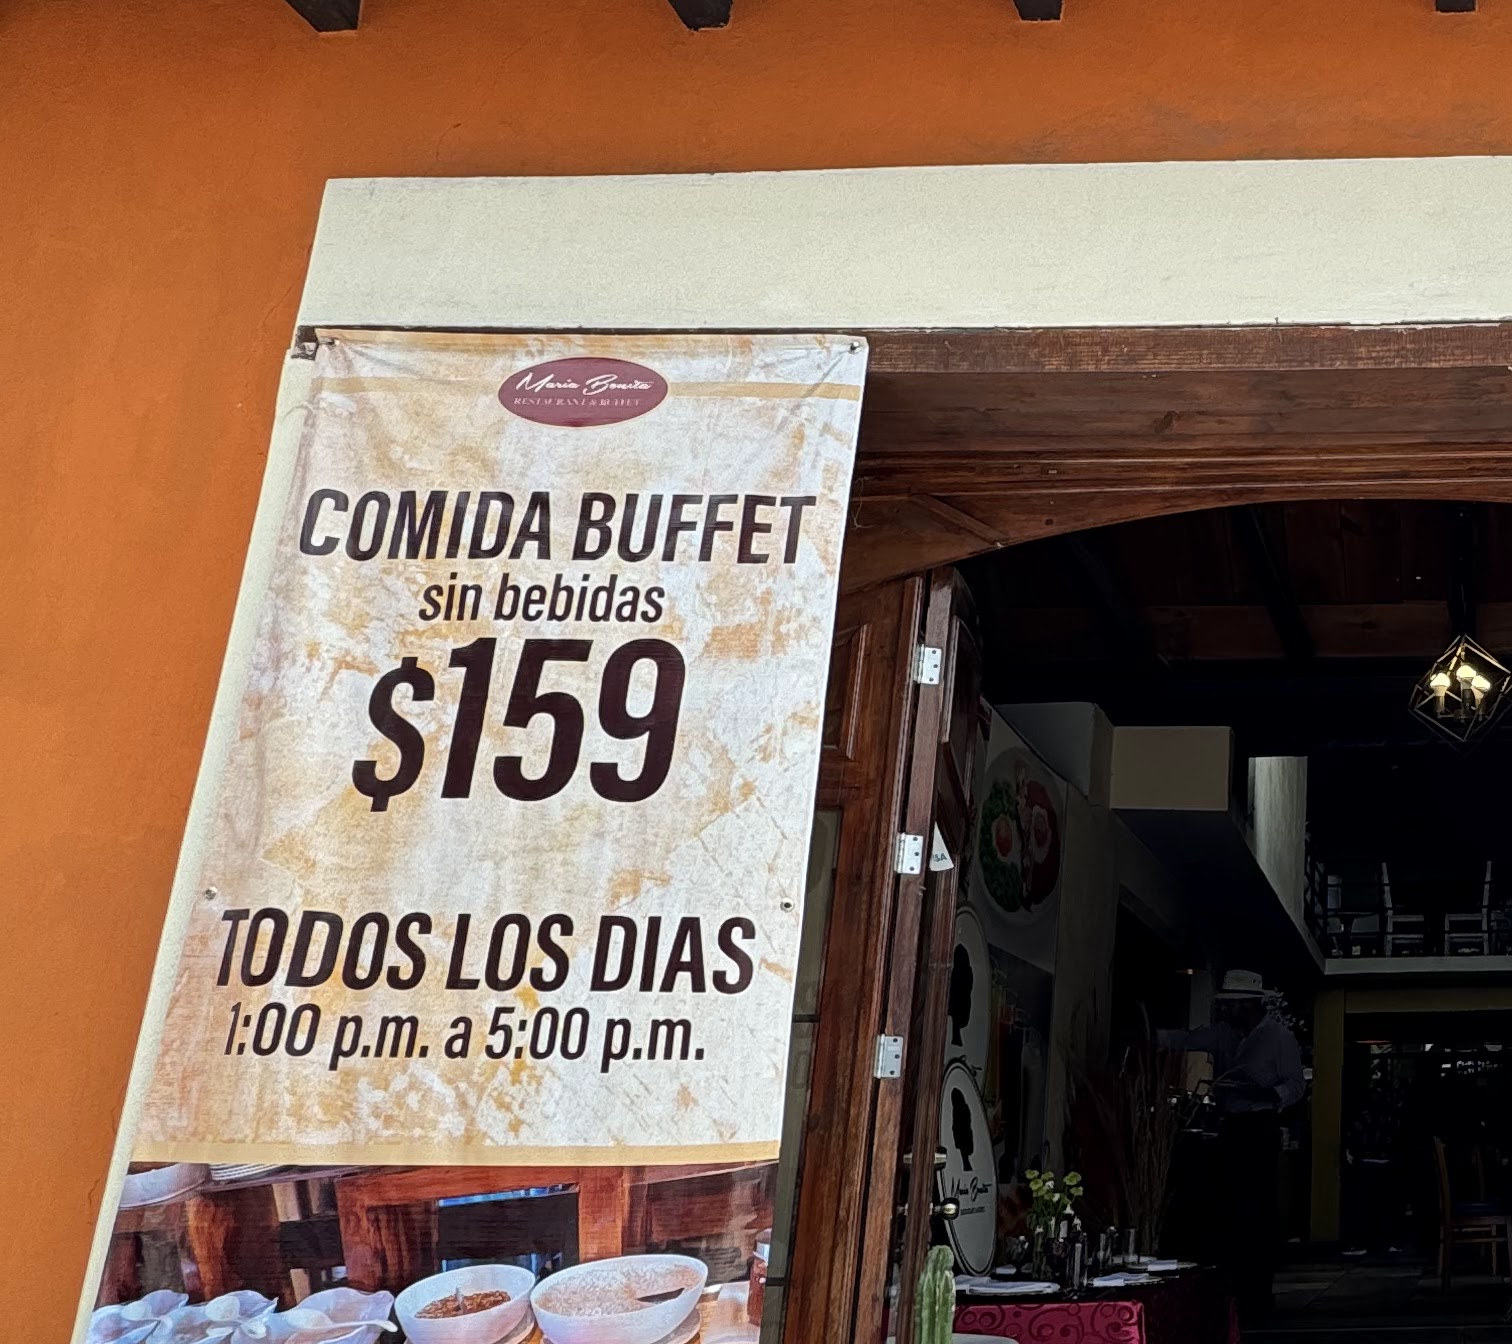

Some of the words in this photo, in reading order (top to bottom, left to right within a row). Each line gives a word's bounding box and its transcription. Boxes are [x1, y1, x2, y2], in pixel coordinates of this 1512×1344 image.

[582, 373, 655, 396] Bonita
[299, 488, 552, 561] COMIDA
[571, 493, 817, 564] BUFFET
[418, 572, 483, 622] sin
[493, 573, 666, 623] bebidas
[351, 637, 686, 813] $159
[215, 907, 433, 991] TODOS
[444, 913, 576, 993] LOS
[590, 915, 757, 995] DIAS
[223, 1001, 322, 1057] 1:00
[328, 1015, 429, 1071] p.m.
[444, 1015, 473, 1059] a
[484, 1005, 591, 1060] 5:00
[600, 1016, 706, 1073] p.m.
